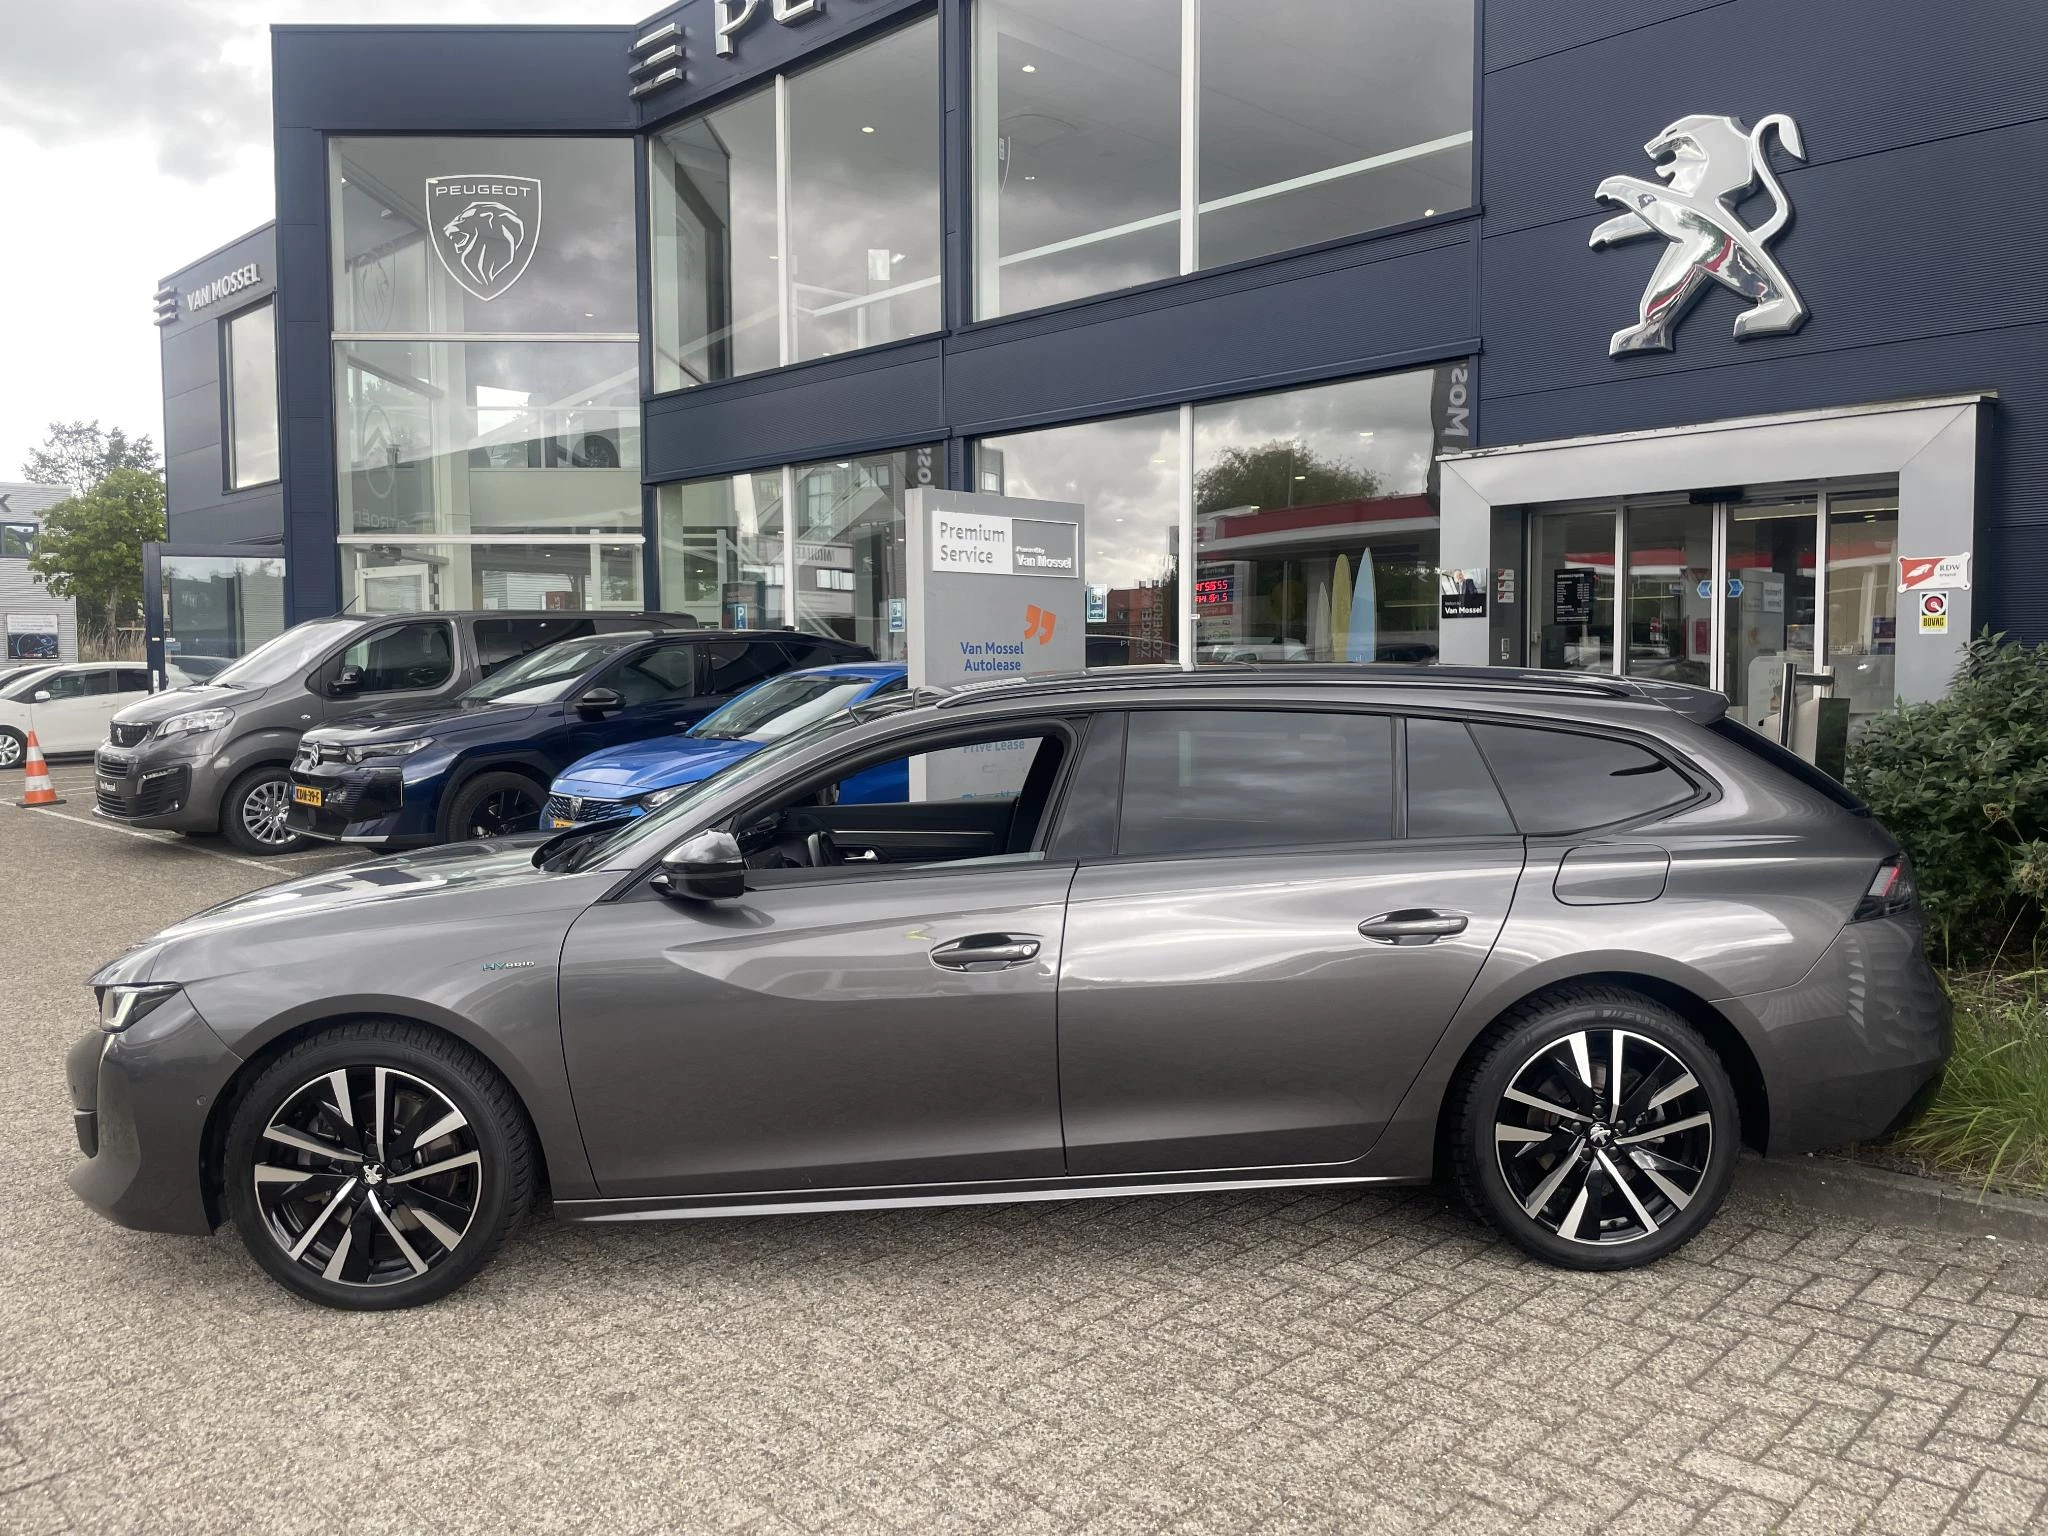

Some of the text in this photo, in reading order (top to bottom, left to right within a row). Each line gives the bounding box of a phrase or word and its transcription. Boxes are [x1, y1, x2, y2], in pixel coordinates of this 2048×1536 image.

[436, 184, 531, 197] PEUGEOT
[187, 263, 261, 311] VAN MOSSEL
[940, 521, 1005, 542] Premium
[940, 544, 994, 563] Service
[1016, 553, 1072, 569] Van Mossel
[1939, 563, 1961, 572] RDW
[1444, 605, 1483, 614] Van Mossel
[1923, 617, 1945, 627] BOVAG
[960, 641, 1025, 655] Van Mossel
[964, 658, 1021, 672] Autolease
[995, 740, 1025, 752] Lease
